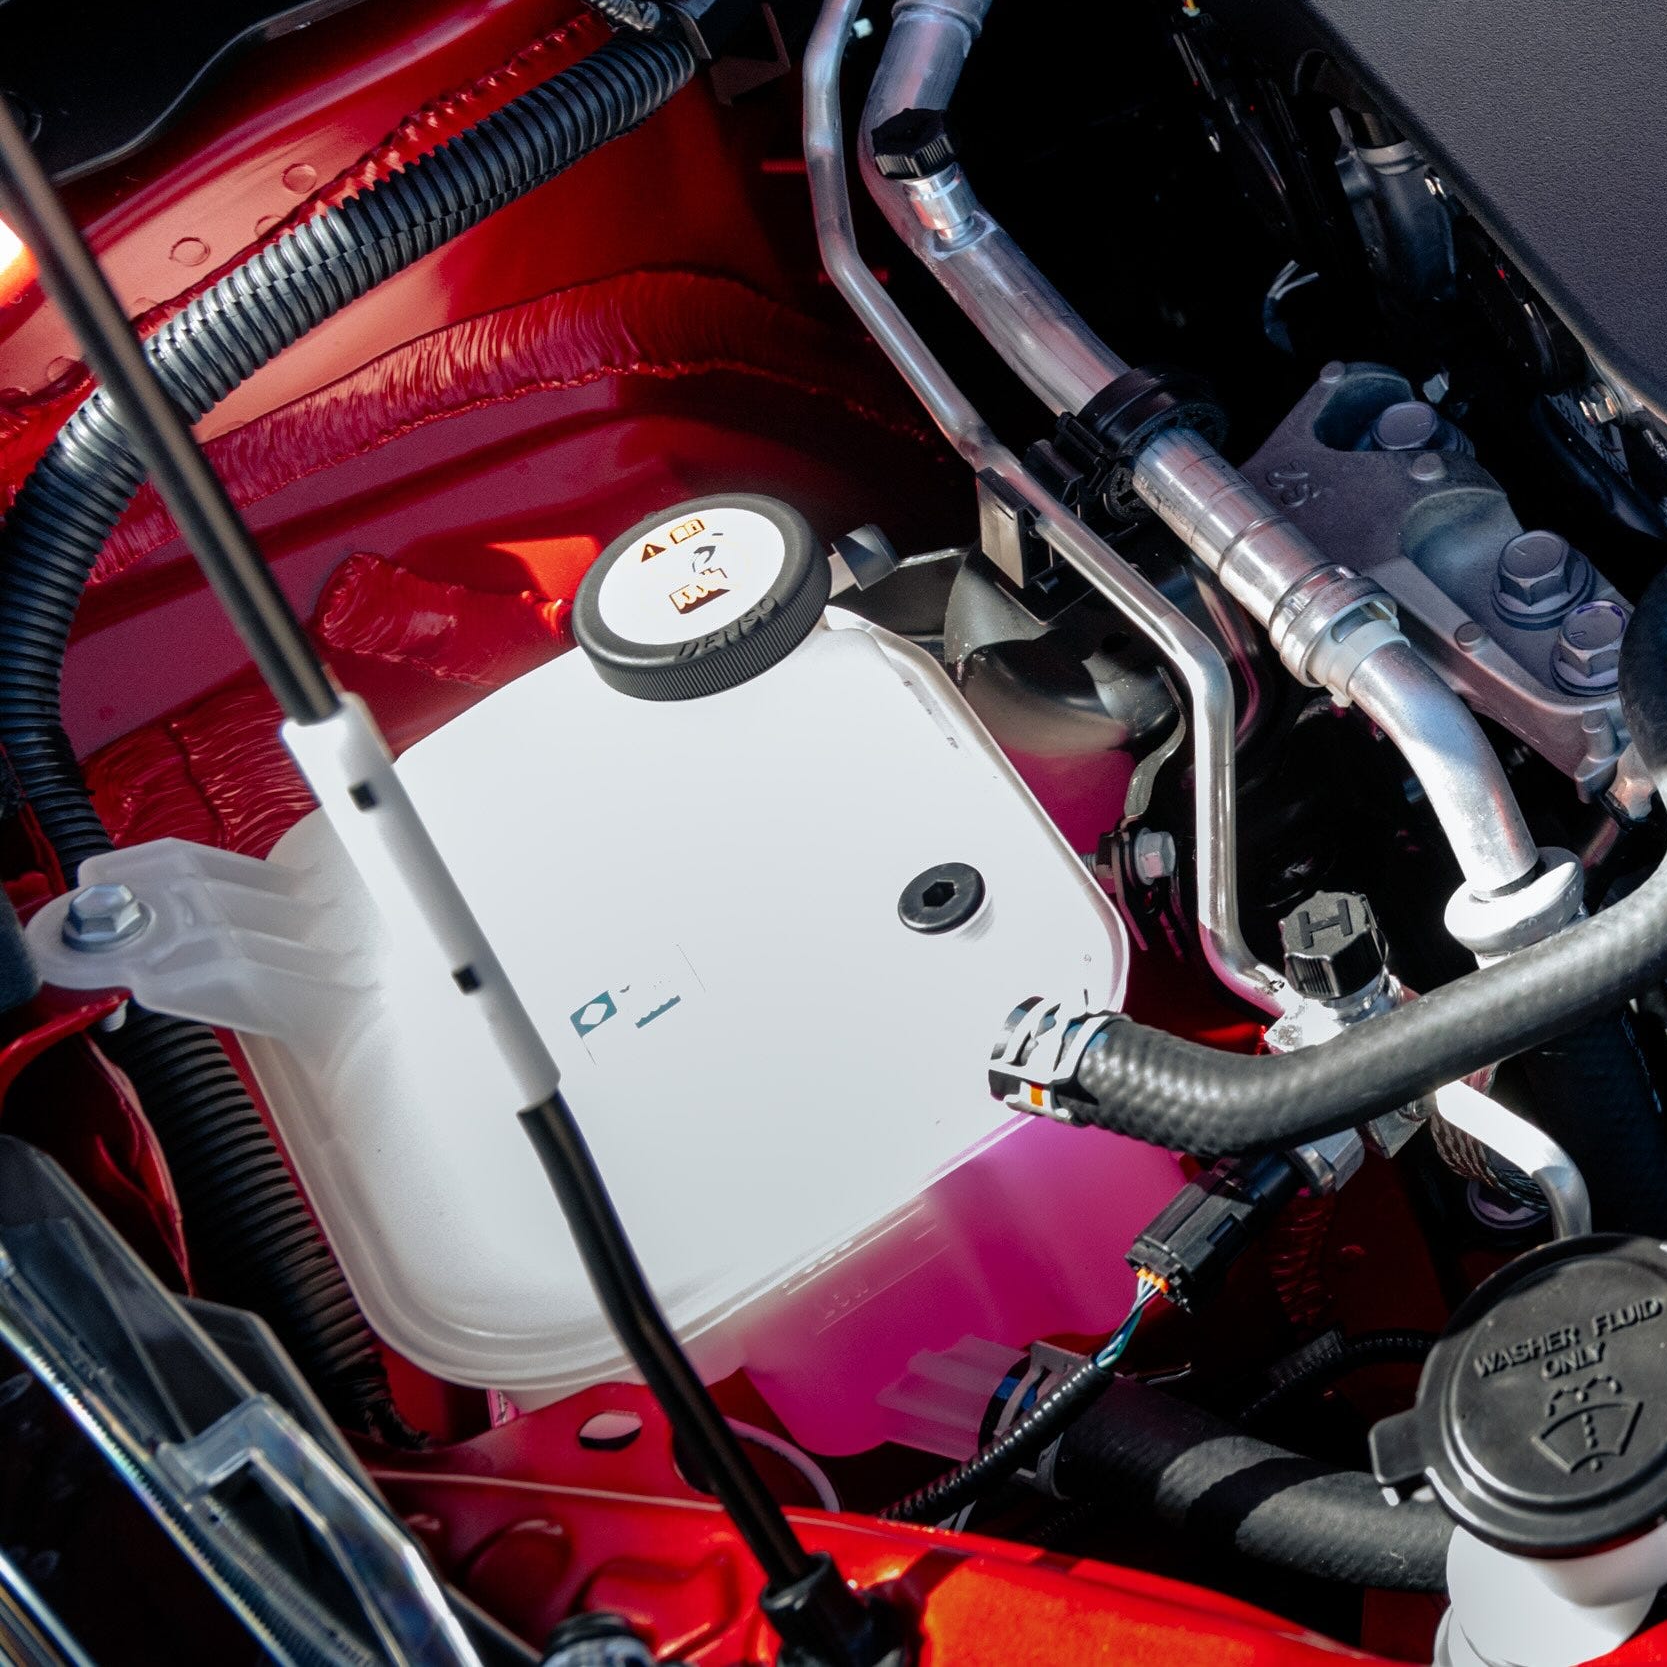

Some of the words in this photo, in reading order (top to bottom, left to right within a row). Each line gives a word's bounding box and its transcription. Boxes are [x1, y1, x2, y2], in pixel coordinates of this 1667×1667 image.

[674, 594, 779, 660] DENSO
[1296, 898, 1354, 950] H
[1472, 1327, 1581, 1379] WASHER
[1590, 1296, 1665, 1339] FLUID
[1540, 1340, 1609, 1381] ONLY
